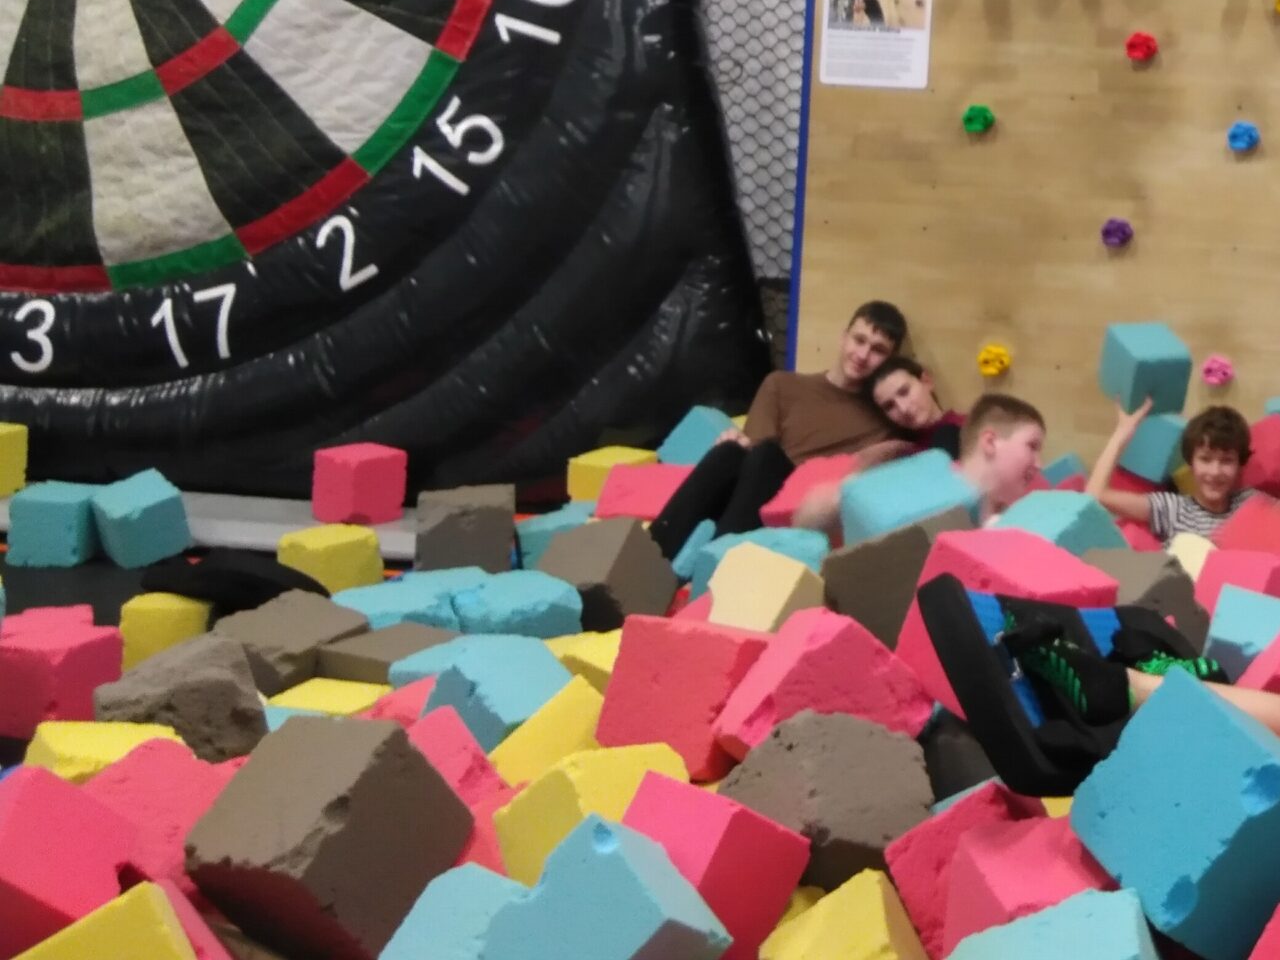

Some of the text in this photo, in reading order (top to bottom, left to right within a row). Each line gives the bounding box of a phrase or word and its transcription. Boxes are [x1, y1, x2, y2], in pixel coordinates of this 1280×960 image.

[412, 96, 504, 195] 15
[316, 215, 379, 290] 2
[11, 299, 55, 373] 3
[151, 283, 237, 367] 17
